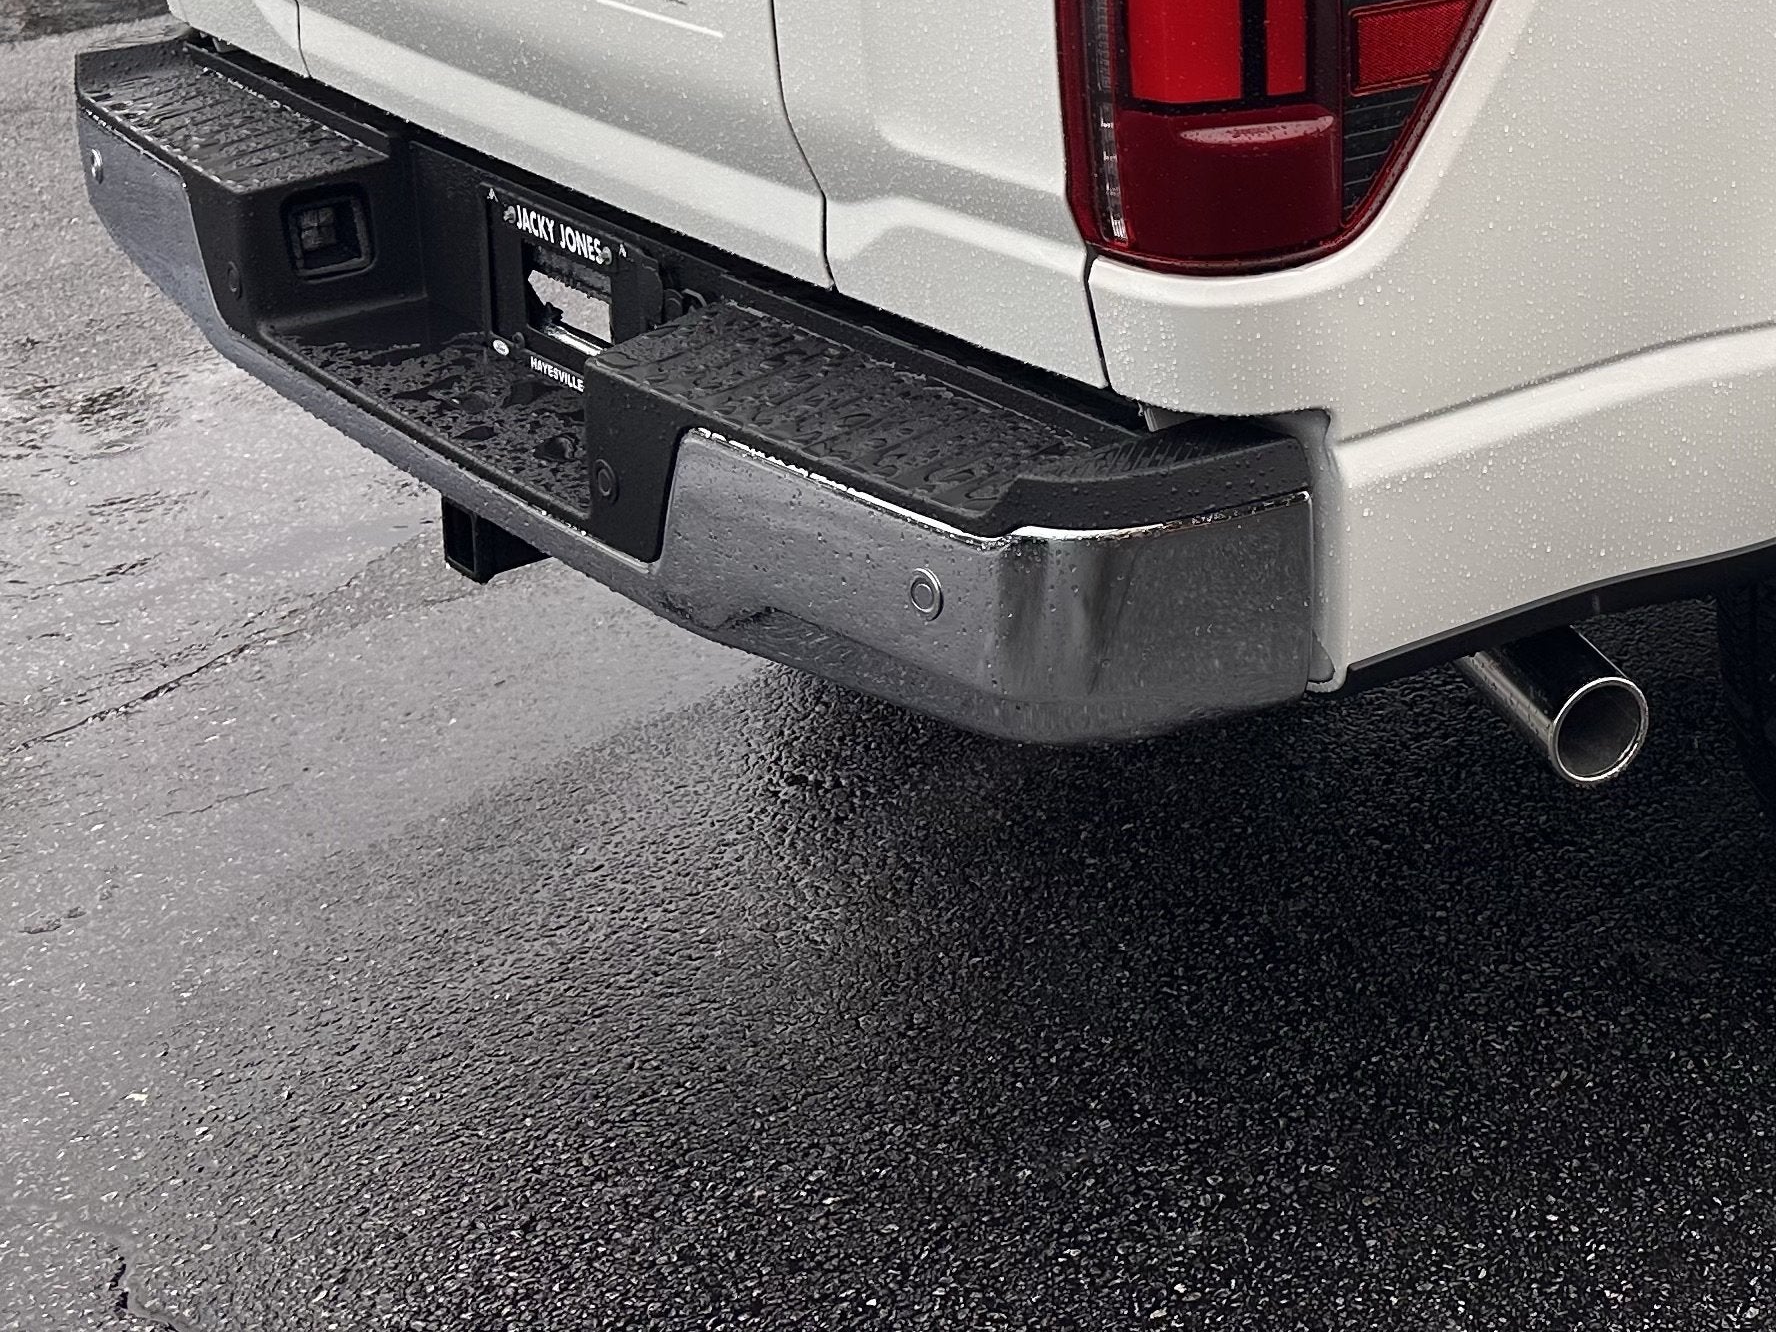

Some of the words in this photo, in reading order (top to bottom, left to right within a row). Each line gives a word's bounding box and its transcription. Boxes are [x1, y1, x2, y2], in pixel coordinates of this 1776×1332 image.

[516, 204, 555, 244] JACKY
[559, 223, 605, 265] JONES
[530, 355, 585, 393] HAYESVILLE
